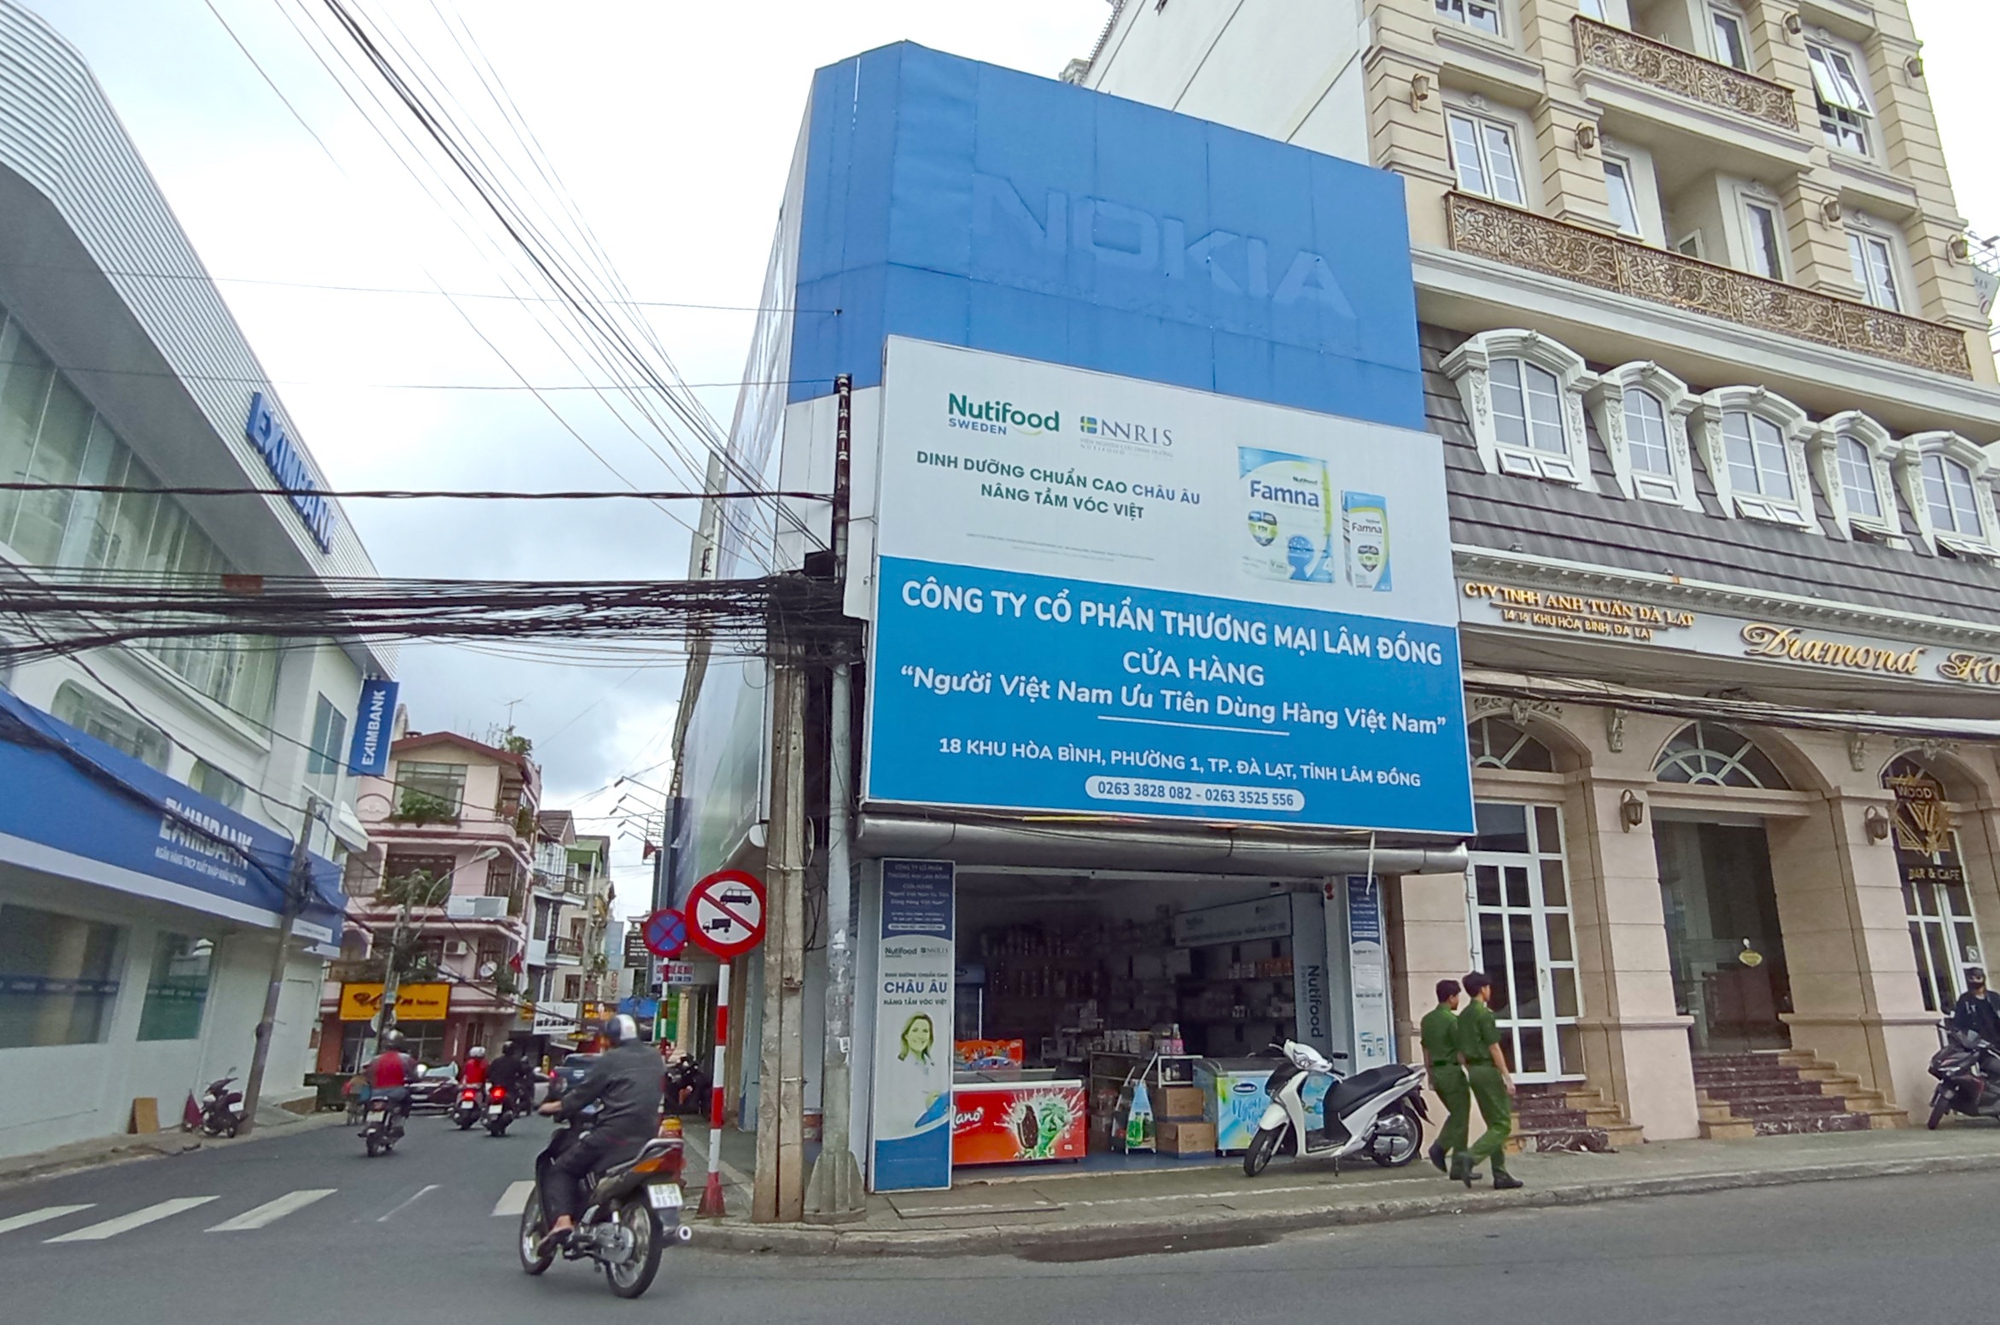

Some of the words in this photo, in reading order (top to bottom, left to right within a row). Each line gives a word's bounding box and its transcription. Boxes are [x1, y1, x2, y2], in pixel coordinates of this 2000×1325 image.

[973, 170, 1357, 320] NOKIA
[948, 393, 1060, 432] Nutifood
[948, 417, 1007, 435] SWEDEN
[246, 391, 338, 554] EXIMBANK
[917, 450, 958, 469] DINH
[964, 458, 1025, 478] DƯỠNG
[1030, 467, 1088, 488] CHUẨN
[1092, 478, 1127, 494] CAO
[1132, 483, 1175, 501] CHÂU
[1180, 488, 1201, 505] ÂU
[981, 483, 1030, 502] NÂNG
[1073, 496, 1109, 513] VÓC
[1113, 502, 1144, 521] VIỆT
[1250, 480, 1320, 507] Famna
[1352, 522, 1382, 534] Famna
[1464, 582, 1498, 598] CTY
[1500, 587, 1542, 605] TNHH
[1545, 593, 1584, 612] ANH
[902, 576, 983, 614] CÔNG
[990, 590, 1027, 618] TY
[1034, 588, 1073, 623] CỔ
[1080, 596, 1155, 633] PHẦN
[1160, 610, 1267, 647] THƯƠNG
[1273, 623, 1317, 657] MẠI
[1323, 625, 1372, 658] LÂM
[1376, 630, 1443, 666] ĐỒNG
[1533, 612, 1556, 626] KHU
[1122, 647, 1181, 678] CỬA
[1188, 654, 1265, 686] HÀNG
[1740, 623, 1925, 675] Diamond
[1000, 674, 1051, 704] Việt
[1057, 680, 1113, 705] Nam
[1120, 683, 1153, 709] Ưu
[1160, 689, 1209, 714] Tiên
[1216, 695, 1275, 724] Dùng
[1282, 701, 1338, 729] Hàng
[1344, 707, 1386, 734] Việt
[361, 690, 386, 766] EXIMBANK
[938, 737, 962, 754] 18
[966, 739, 1006, 757] KHU
[1011, 740, 1053, 760] HÒA
[1058, 743, 1107, 767] BÌNH,
[1111, 749, 1186, 770] PHƯỜNG
[1190, 756, 1204, 774] 1,
[1207, 758, 1233, 774] TP.
[1236, 757, 1262, 776] ĐÀ
[1265, 762, 1297, 781] LẠT,
[1300, 761, 1338, 782] TỈNH
[1341, 765, 1373, 784] LÂM
[1097, 781, 1130, 796] 0263
[1133, 782, 1165, 798] 3828
[1169, 784, 1192, 800] 082
[1205, 788, 1235, 803] 0263
[1238, 791, 1269, 805] 3525
[1272, 793, 1294, 806] 556
[1908, 867, 1925, 881] BAR
[1928, 867, 1936, 879] &
[1937, 868, 1961, 881] CAFE
[885, 947, 917, 955] Nutifood
[884, 979, 925, 993] CHÂU
[928, 979, 947, 993] ÂU
[1307, 965, 1324, 1038] Nutifood
[953, 1105, 984, 1129] lano
